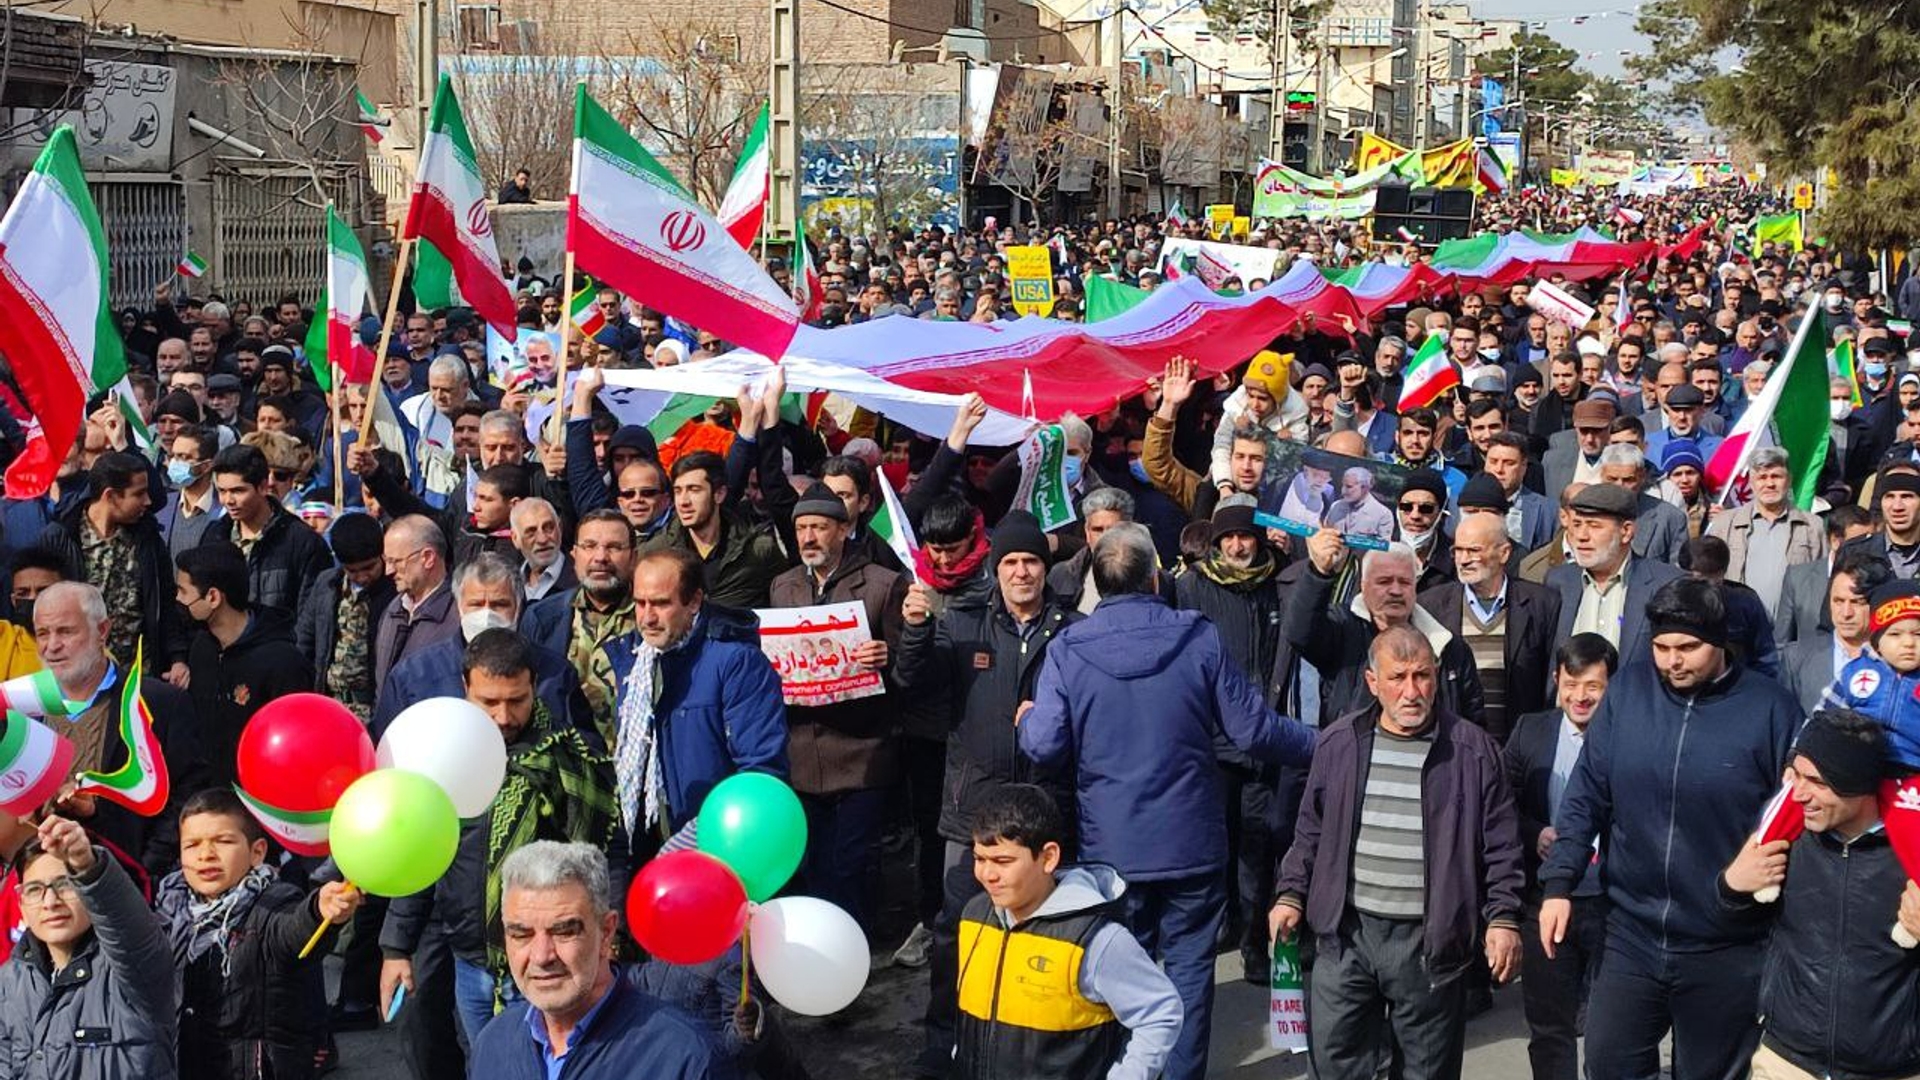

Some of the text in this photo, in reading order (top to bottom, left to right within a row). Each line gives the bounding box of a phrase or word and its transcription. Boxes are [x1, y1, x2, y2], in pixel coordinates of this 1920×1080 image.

[1017, 284, 1048, 300] USA
[757, 608, 859, 635] نهض
[825, 675, 876, 693] continues
[1284, 999, 1302, 1014] ARE
[1277, 1021, 1289, 1035] TO
